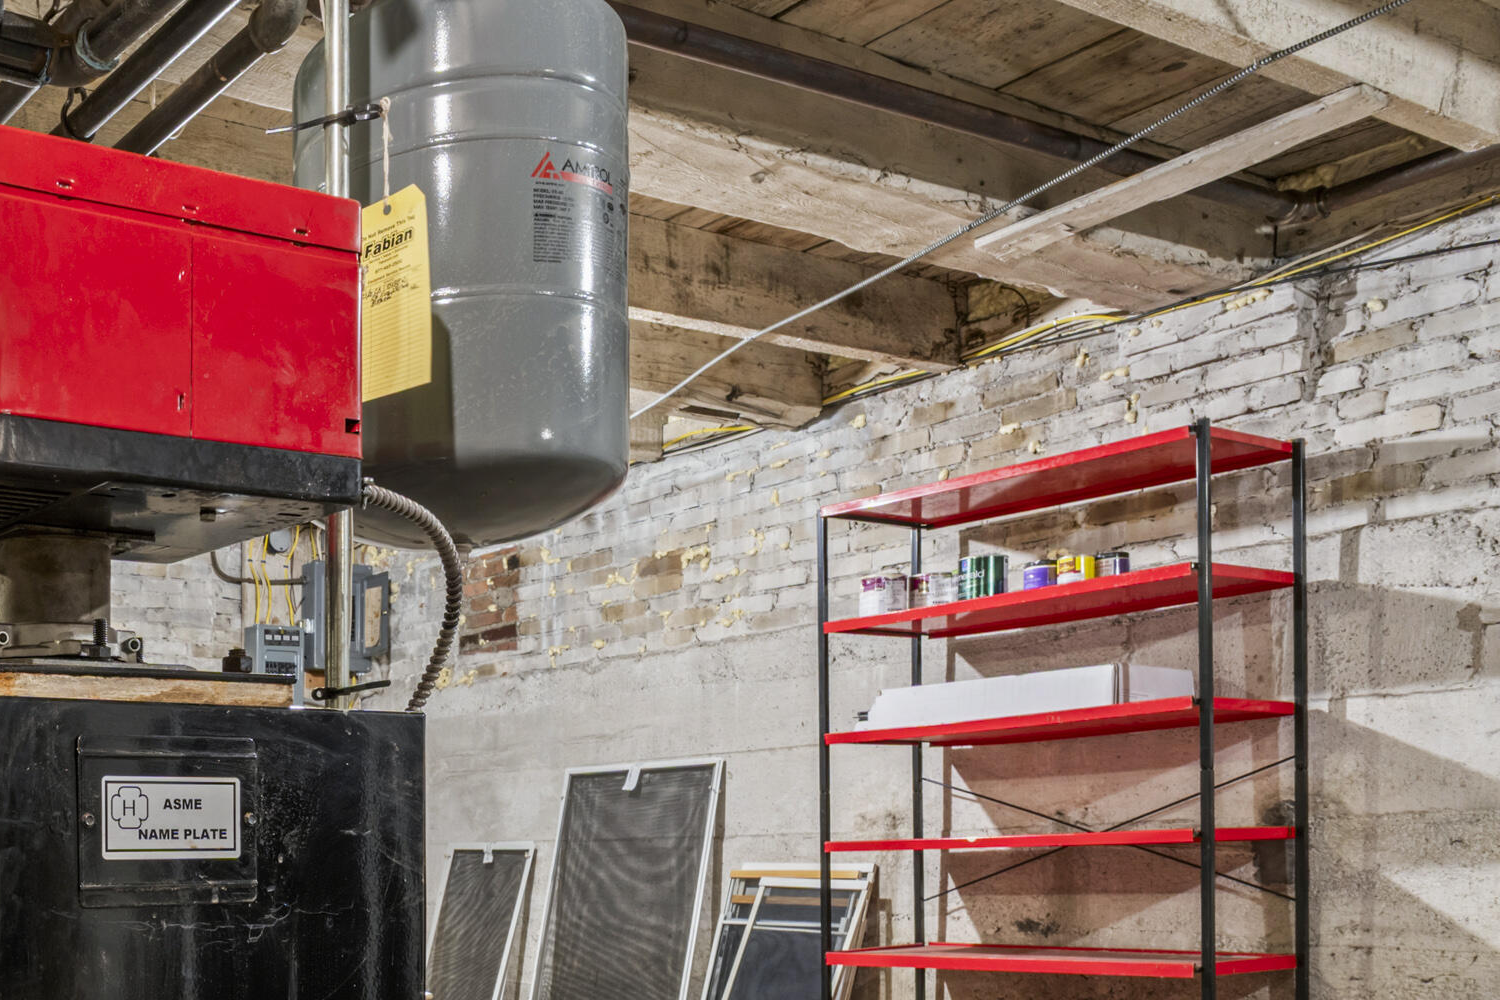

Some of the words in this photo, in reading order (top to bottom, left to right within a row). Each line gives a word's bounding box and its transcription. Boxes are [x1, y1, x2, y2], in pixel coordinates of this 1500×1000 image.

[561, 158, 612, 186] AMTROL
[364, 228, 413, 259] Fabian
[163, 798, 203, 810] ASME
[138, 828, 180, 840] NAME
[184, 828, 228, 840] PLATE
